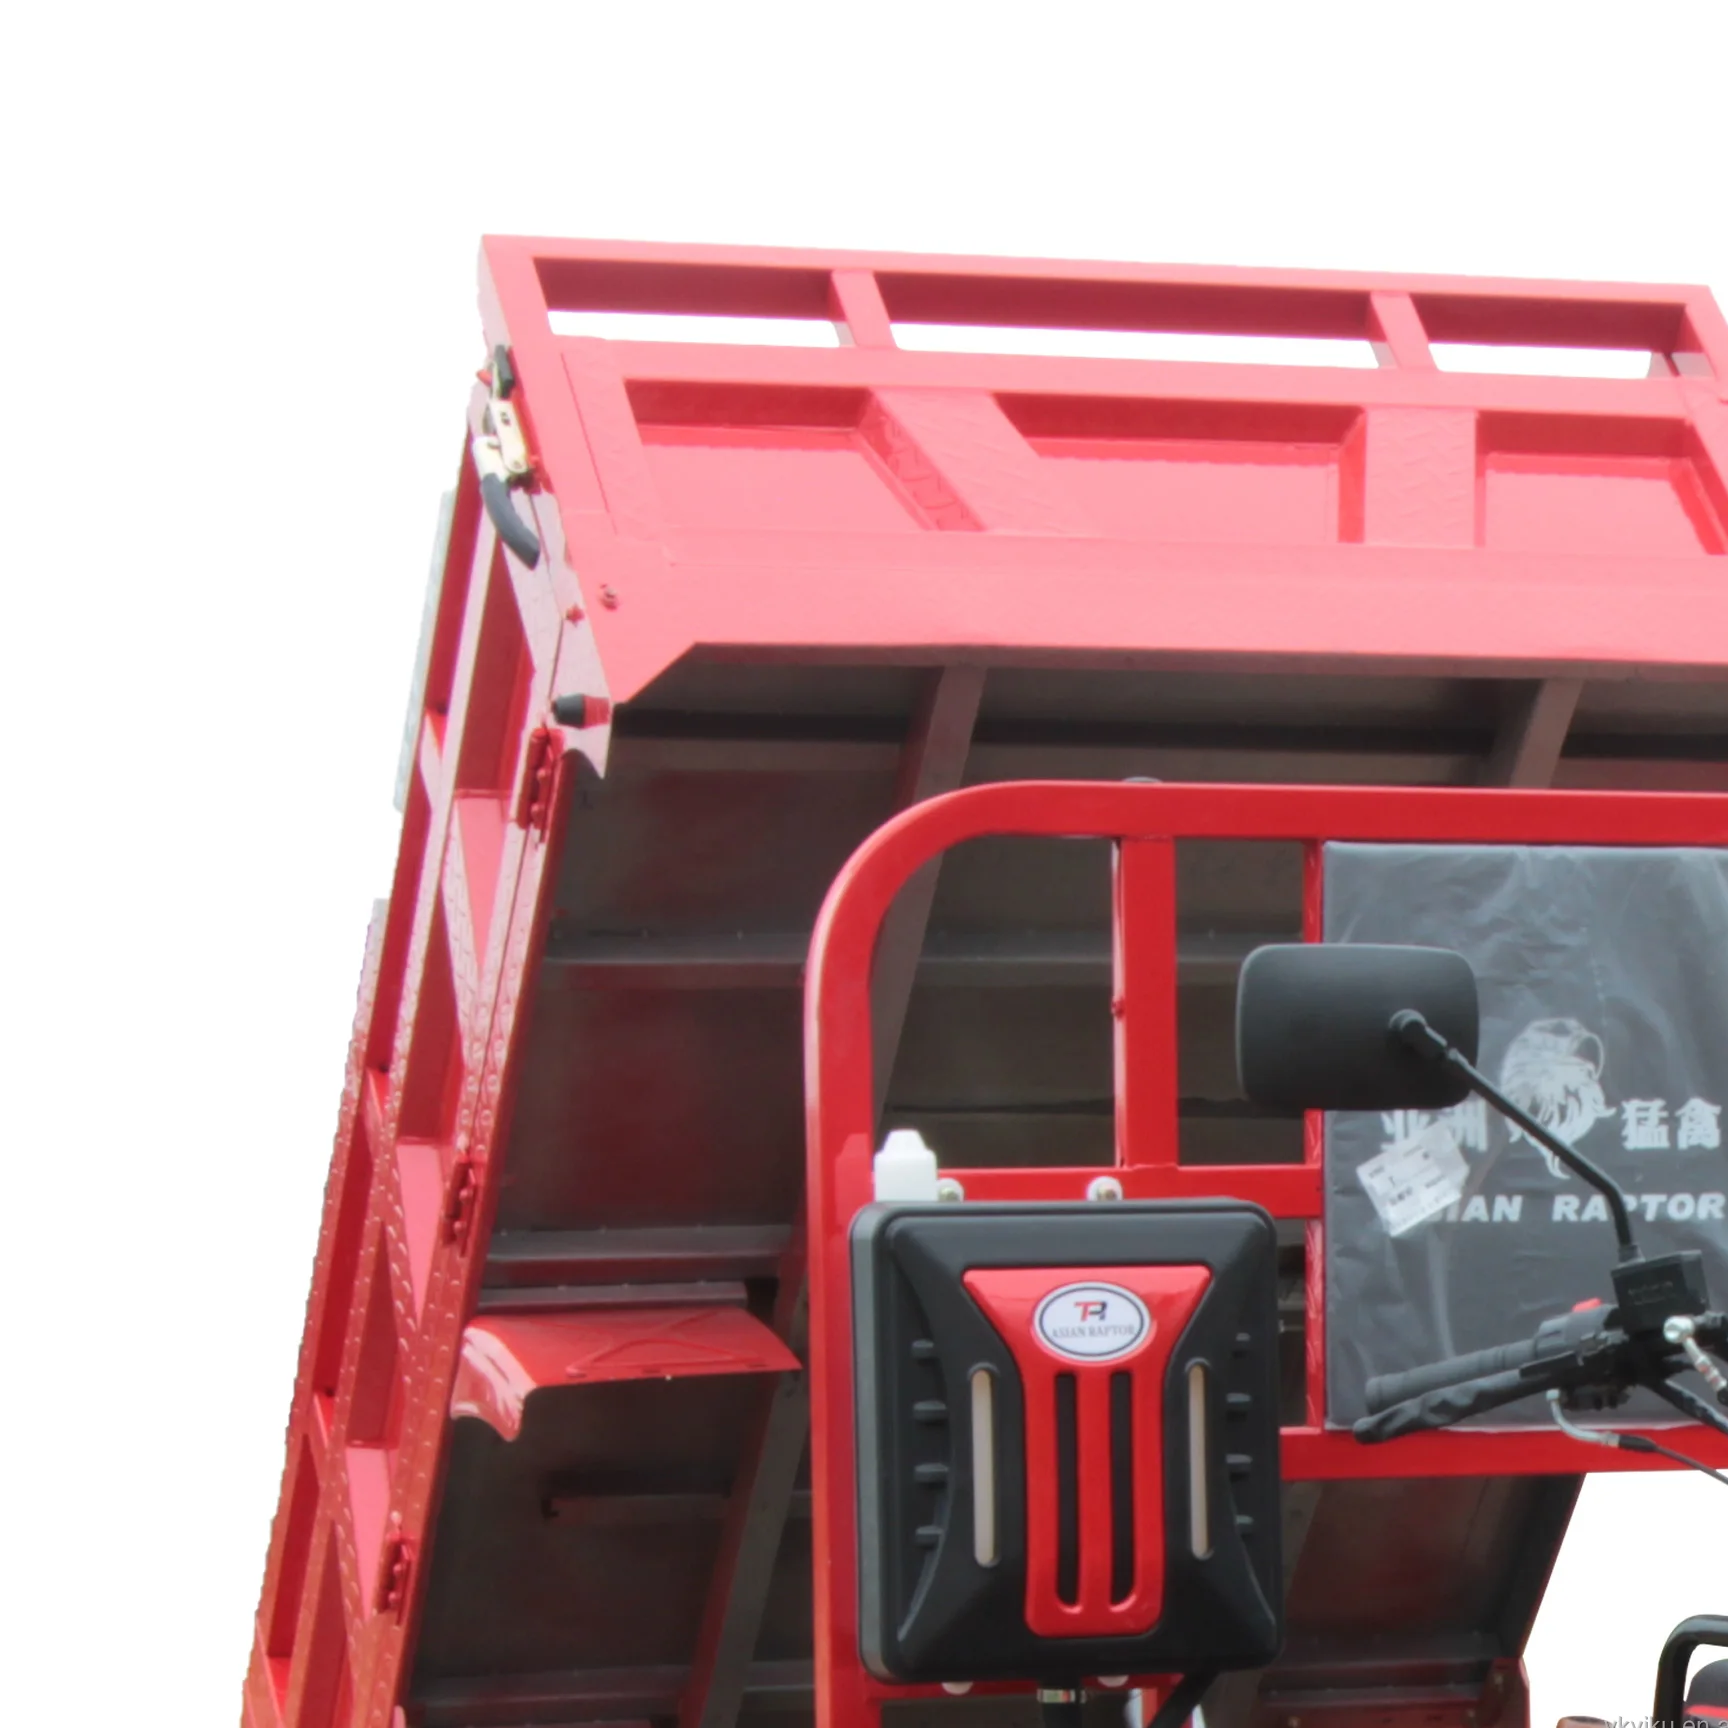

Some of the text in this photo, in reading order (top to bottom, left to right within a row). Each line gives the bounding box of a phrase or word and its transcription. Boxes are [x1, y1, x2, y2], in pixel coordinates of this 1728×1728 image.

[1620, 1097, 1721, 1150] 猛禽
[1416, 1194, 1523, 1222] IAN
[1052, 1324, 1136, 1339] ASIAN RAPTOR
